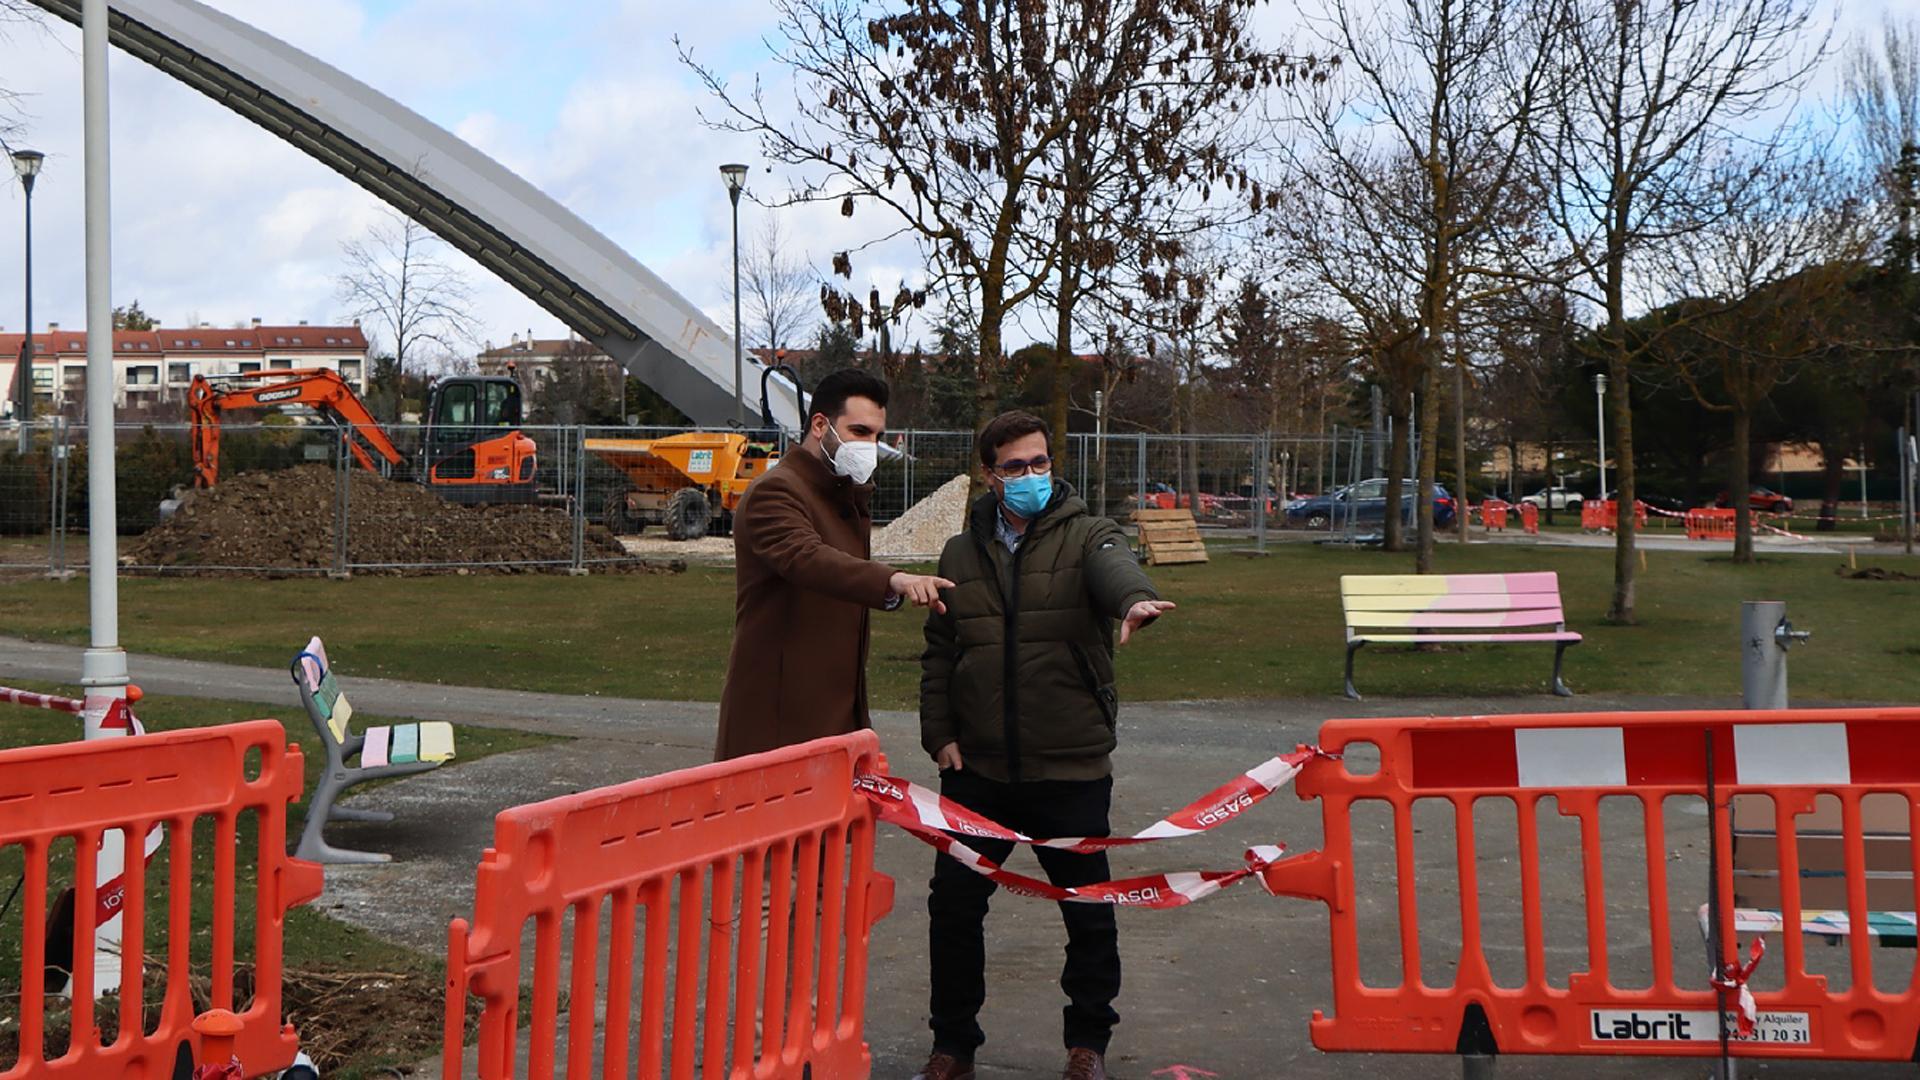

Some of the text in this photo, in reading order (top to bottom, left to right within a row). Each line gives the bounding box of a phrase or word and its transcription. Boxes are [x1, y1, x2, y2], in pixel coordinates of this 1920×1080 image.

[1593, 1012, 1691, 1040] Labrit
[1763, 1014, 1803, 1026] Alquiler
[1772, 1029, 1788, 1041] 20
[1793, 1029, 1807, 1042] 31
